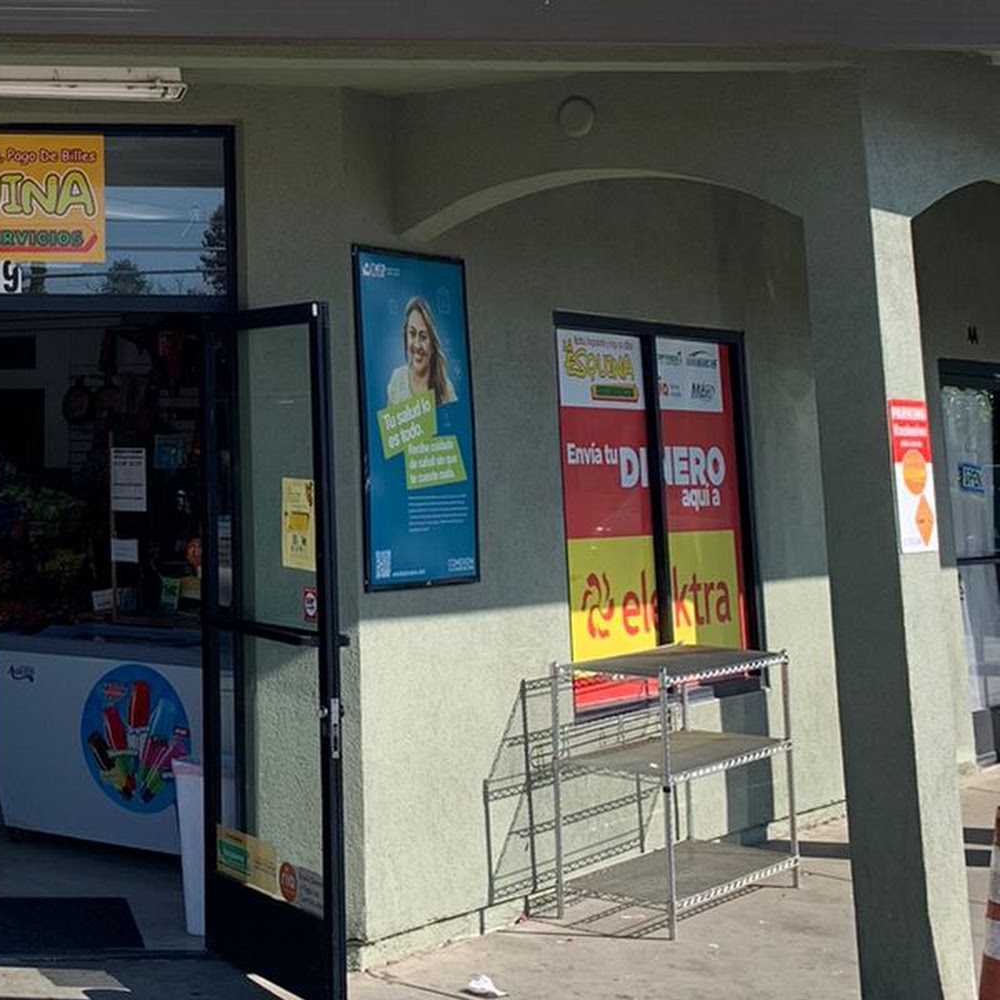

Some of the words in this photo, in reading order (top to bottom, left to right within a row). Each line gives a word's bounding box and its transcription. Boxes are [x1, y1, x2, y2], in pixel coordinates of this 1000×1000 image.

[6, 149, 36, 165] Pago
[38, 148, 57, 163] De
[60, 149, 97, 164] Billes
[564, 348, 635, 382] ESQUINA
[567, 443, 601, 464] Envía
[604, 445, 618, 464] tu
[682, 484, 710, 511] aquí
[712, 489, 720, 505] a
